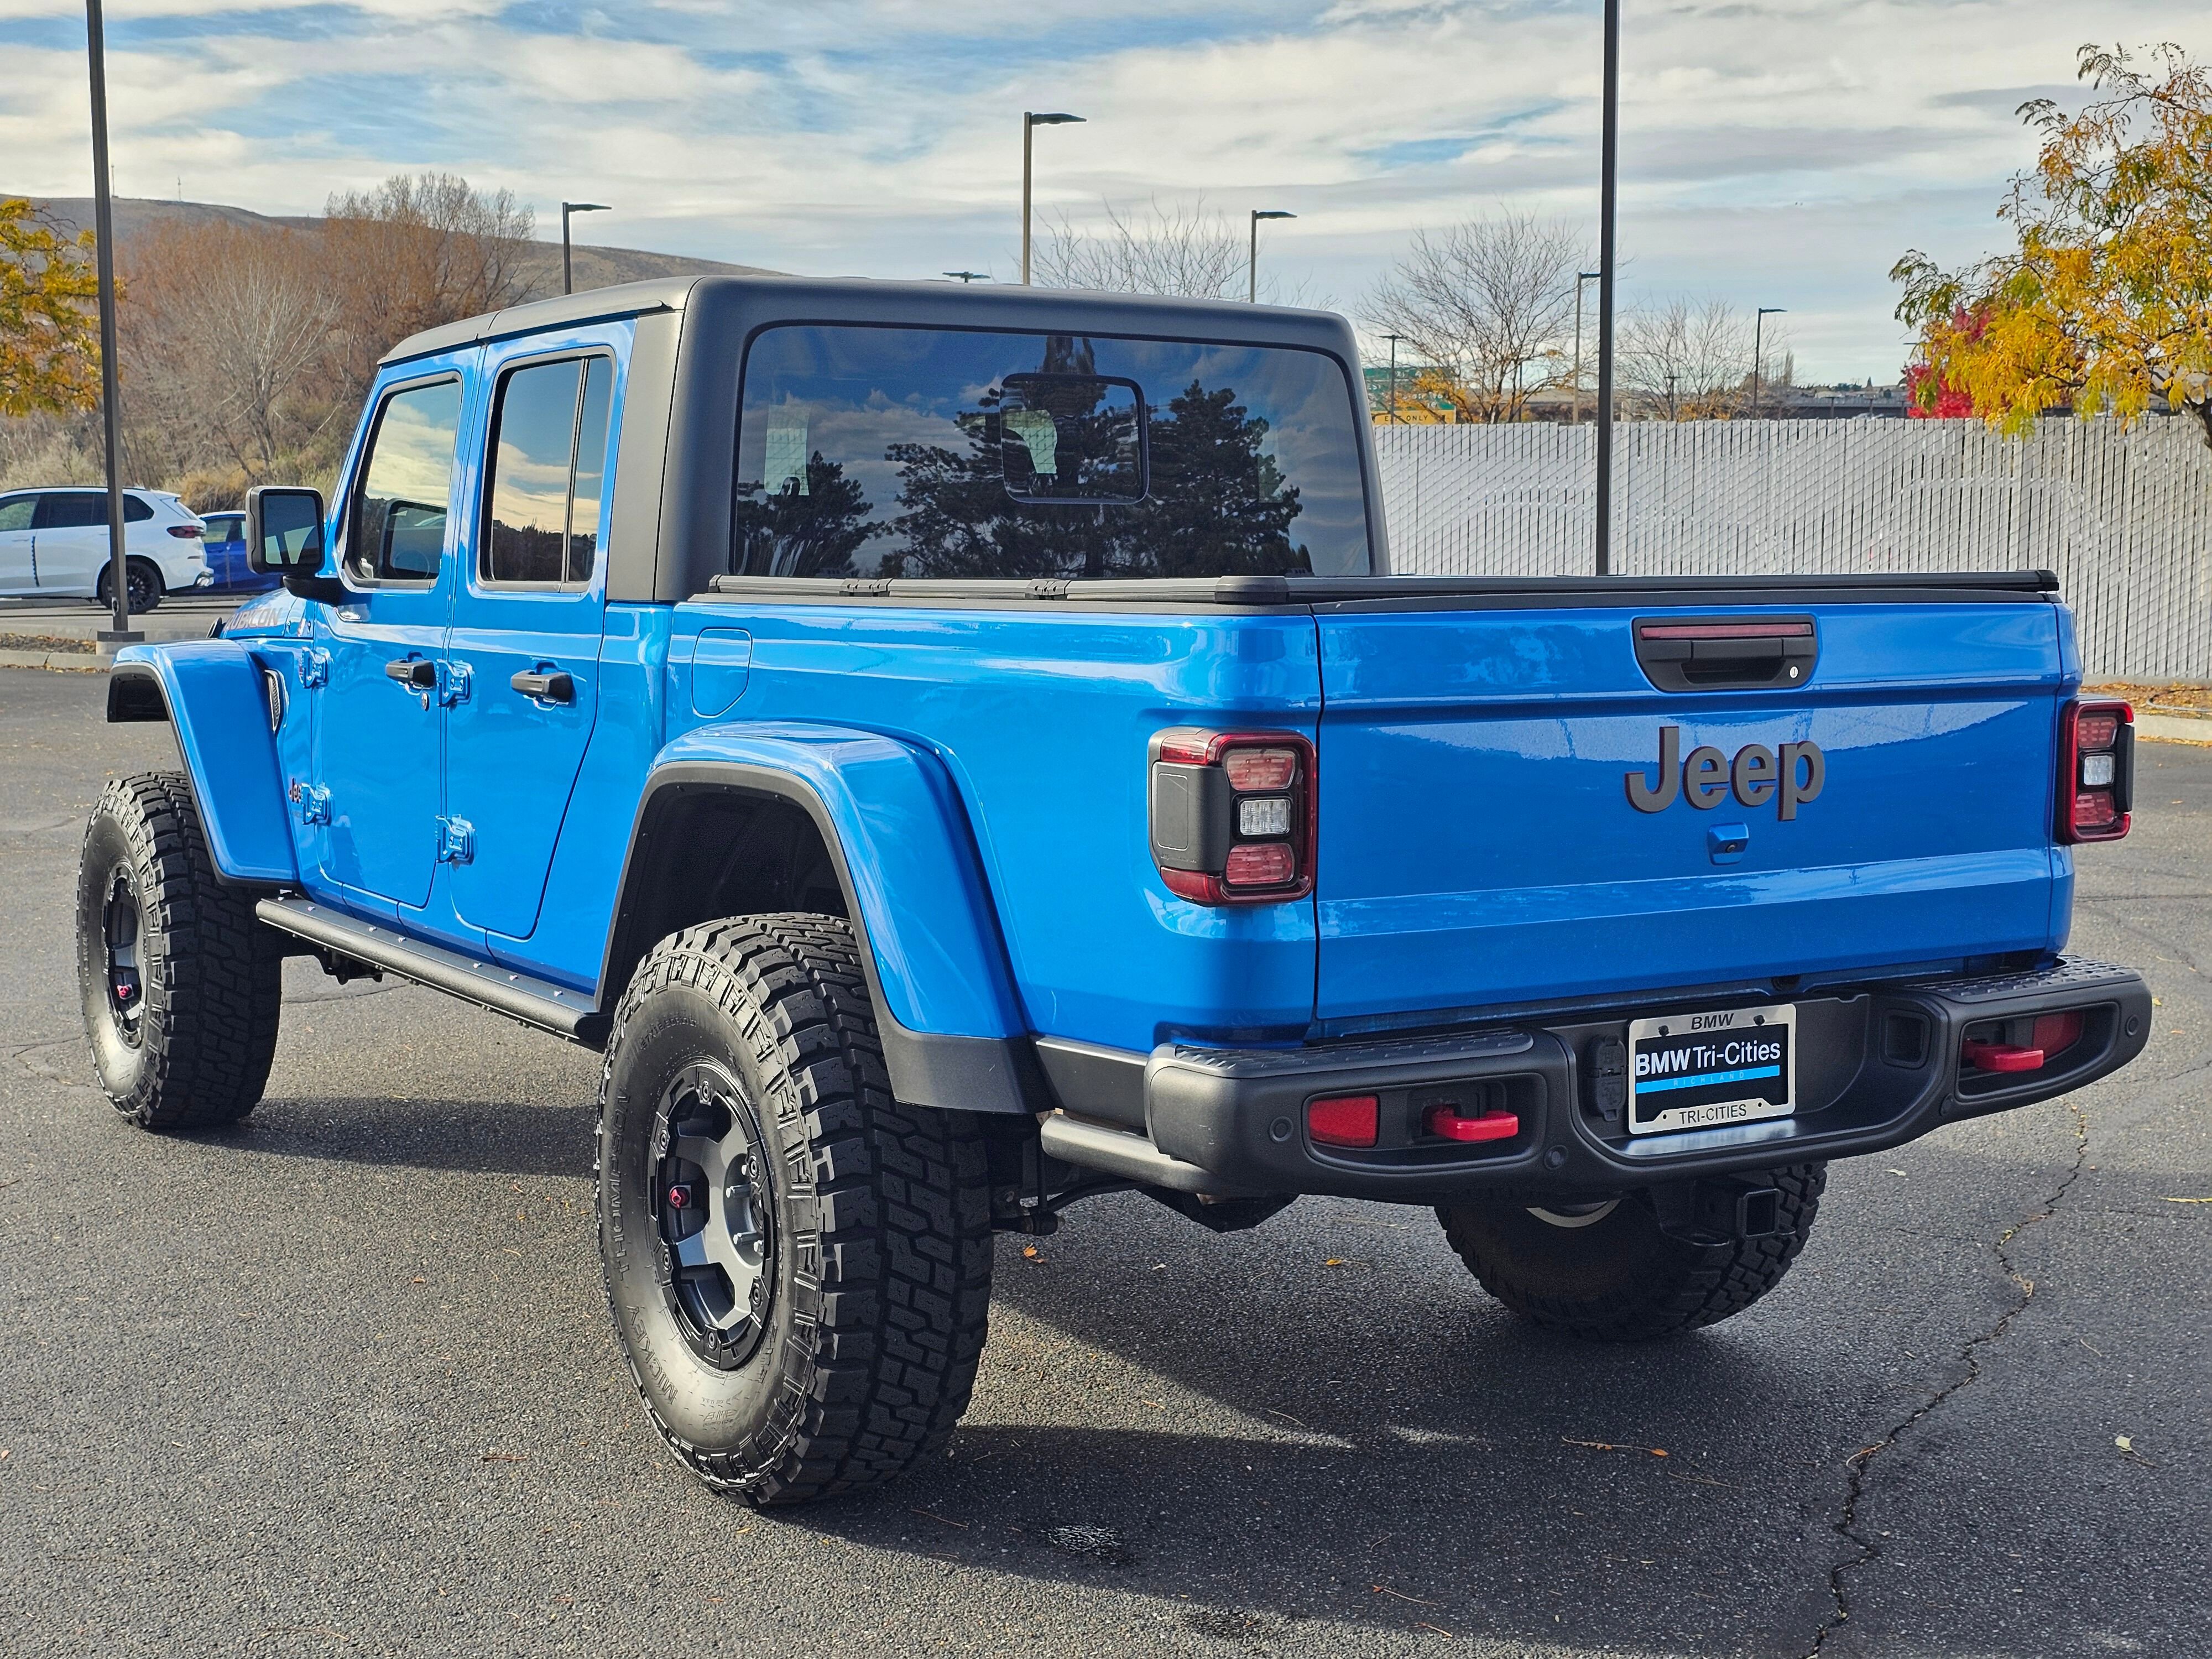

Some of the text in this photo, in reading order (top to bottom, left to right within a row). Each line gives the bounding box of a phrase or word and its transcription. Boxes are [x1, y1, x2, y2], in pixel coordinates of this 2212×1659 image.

[223, 608, 284, 632] RUBICON
[1624, 726, 1825, 822] Jeep
[1691, 1013, 1734, 1030] BMW
[1635, 1048, 1691, 1076] BMW
[1692, 1040, 1781, 1068] Tri-Cities
[1673, 1072, 1745, 1087] RICHLAND
[1679, 1104, 1747, 1125] TRI-CITIES
[609, 1087, 630, 1281] THOMPSON
[626, 1306, 679, 1405] MICKEY
